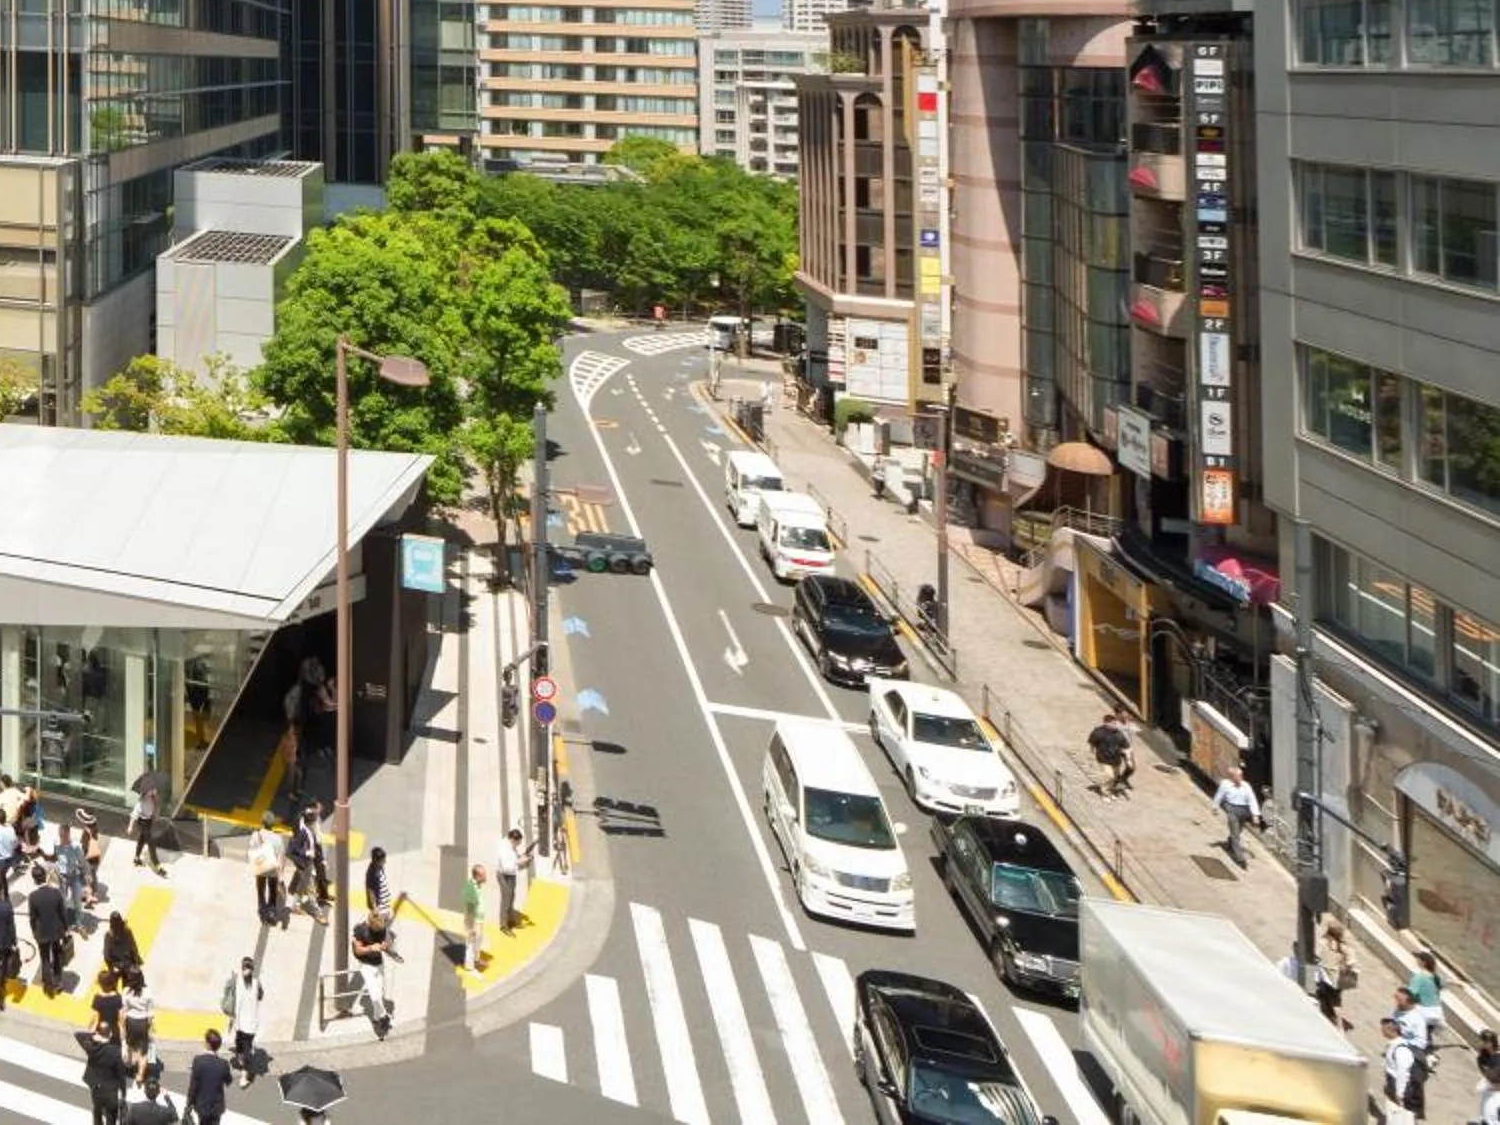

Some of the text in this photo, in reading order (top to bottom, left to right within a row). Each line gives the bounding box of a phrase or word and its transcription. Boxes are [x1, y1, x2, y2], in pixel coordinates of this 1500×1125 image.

[1197, 46, 1219, 56] 6F
[1199, 113, 1220, 124] 5F
[1201, 182, 1222, 192] 4F
[1203, 250, 1223, 260] 3F
[1204, 319, 1225, 330] 2F
[1207, 388, 1226, 399] 1F
